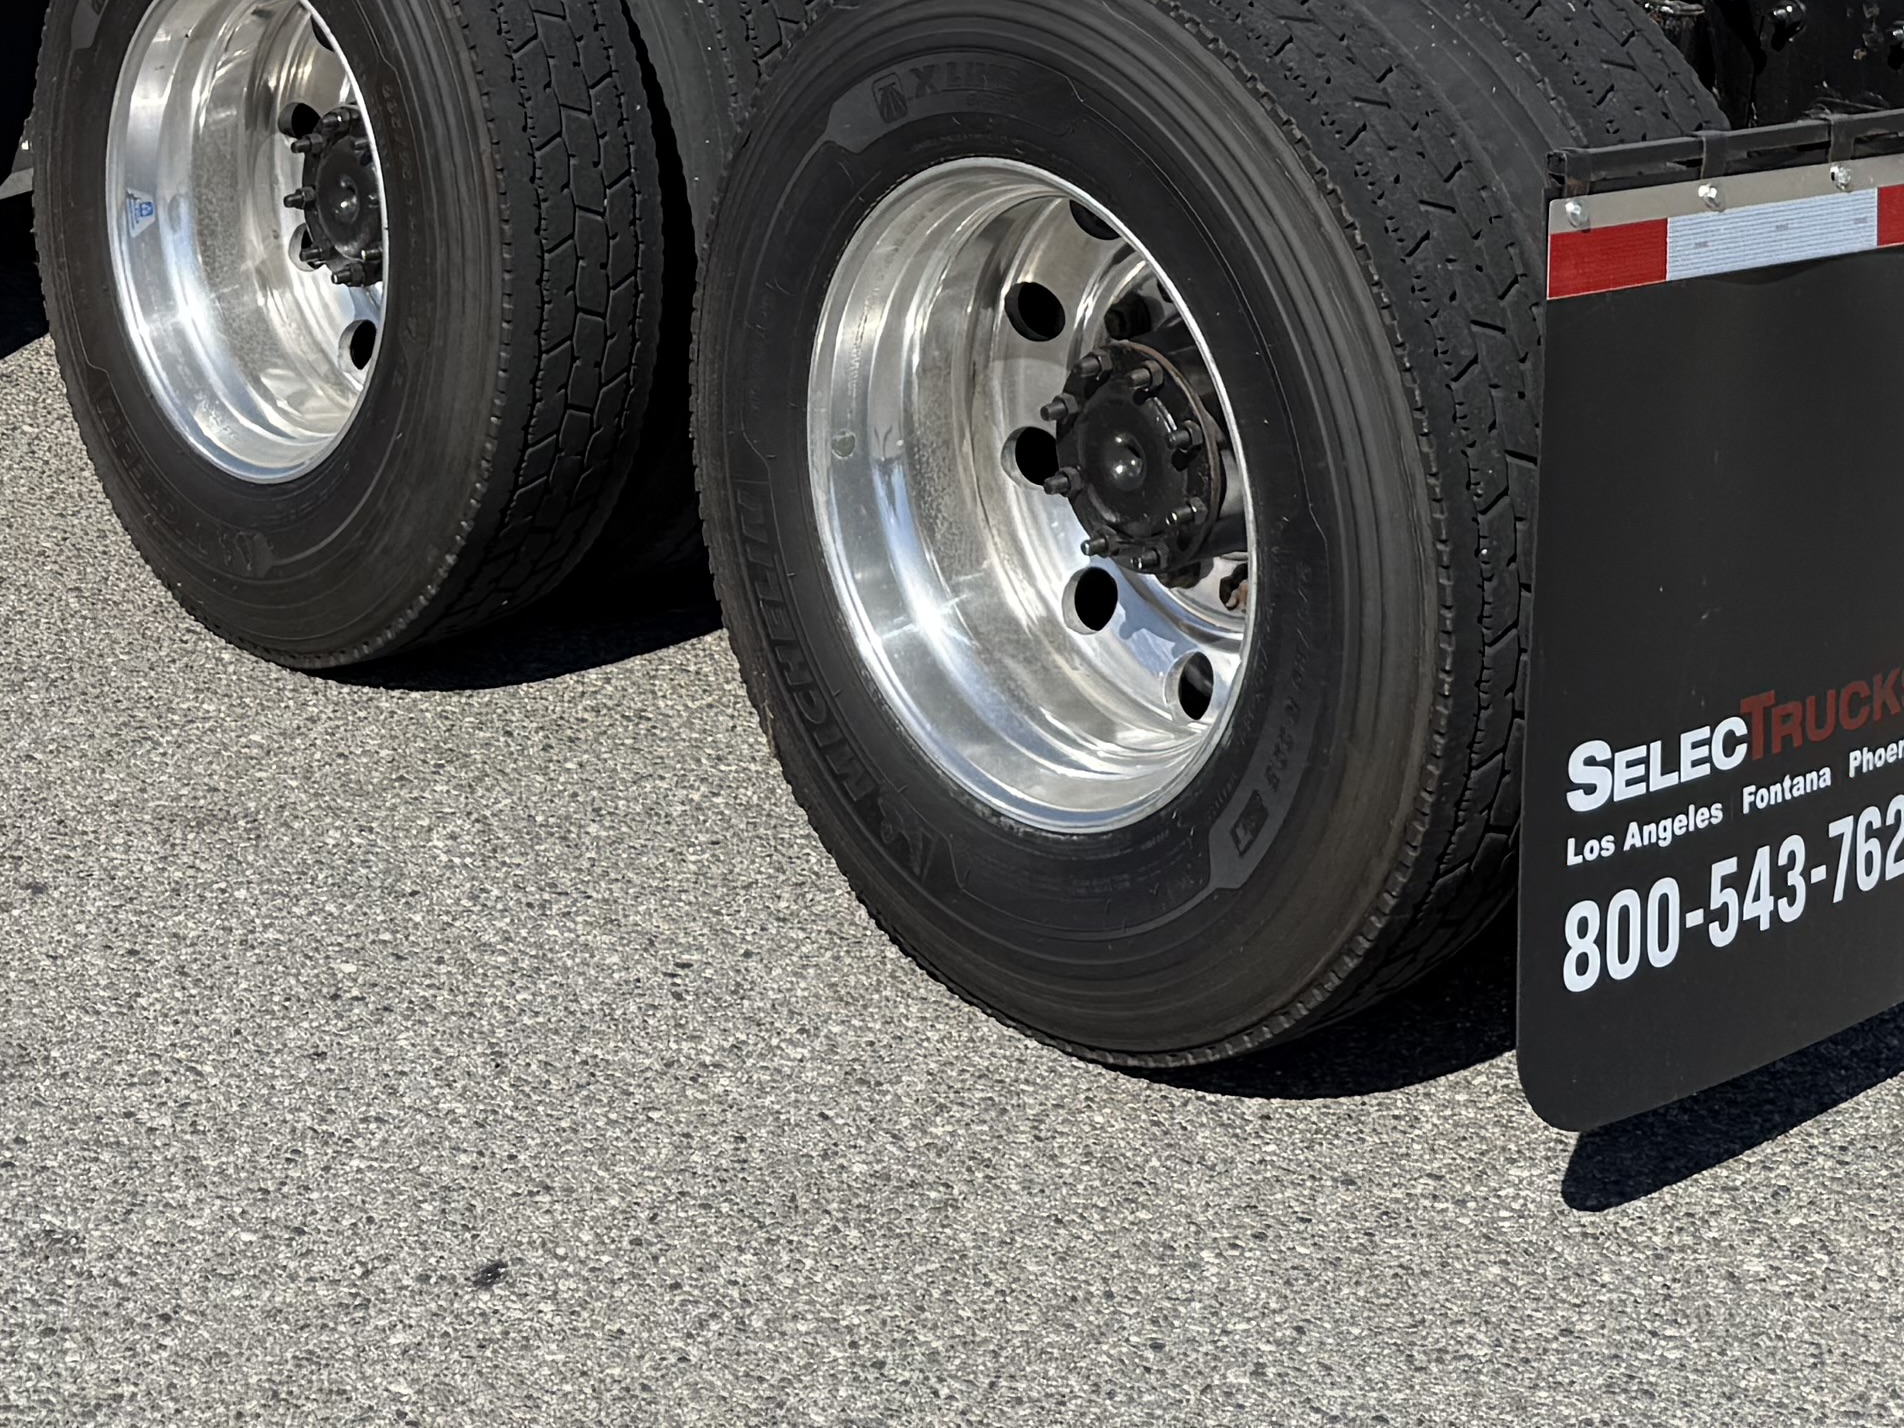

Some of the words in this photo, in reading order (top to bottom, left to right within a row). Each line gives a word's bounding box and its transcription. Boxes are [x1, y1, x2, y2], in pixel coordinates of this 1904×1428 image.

[1566, 831, 1616, 866] Los
[1623, 800, 1723, 852] Angeles
[1742, 766, 1832, 815] Fontana
